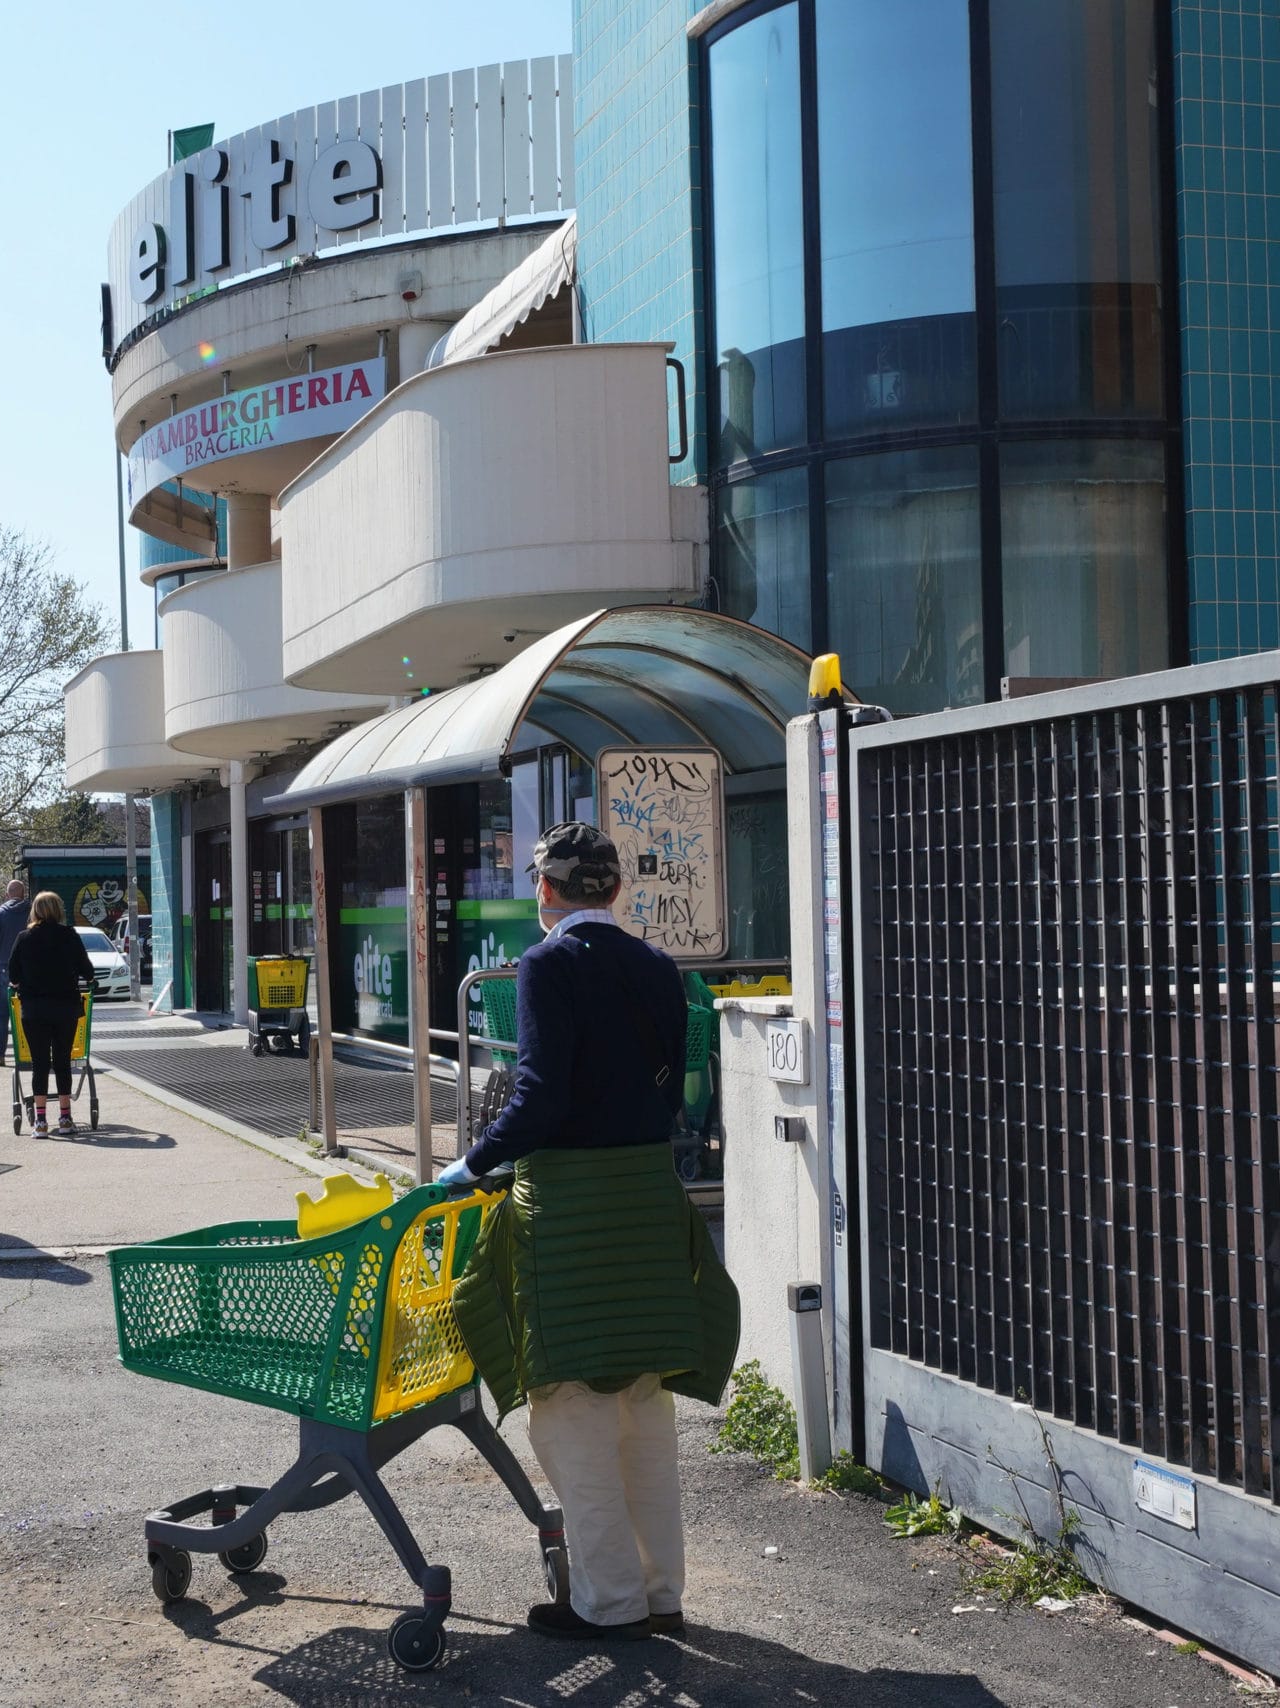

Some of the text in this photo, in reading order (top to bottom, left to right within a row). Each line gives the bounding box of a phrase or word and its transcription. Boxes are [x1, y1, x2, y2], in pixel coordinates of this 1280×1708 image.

[130, 139, 384, 304] elite
[185, 422, 274, 465] BRACERIA
[354, 934, 392, 995] elite
[771, 1033, 797, 1071] 180
